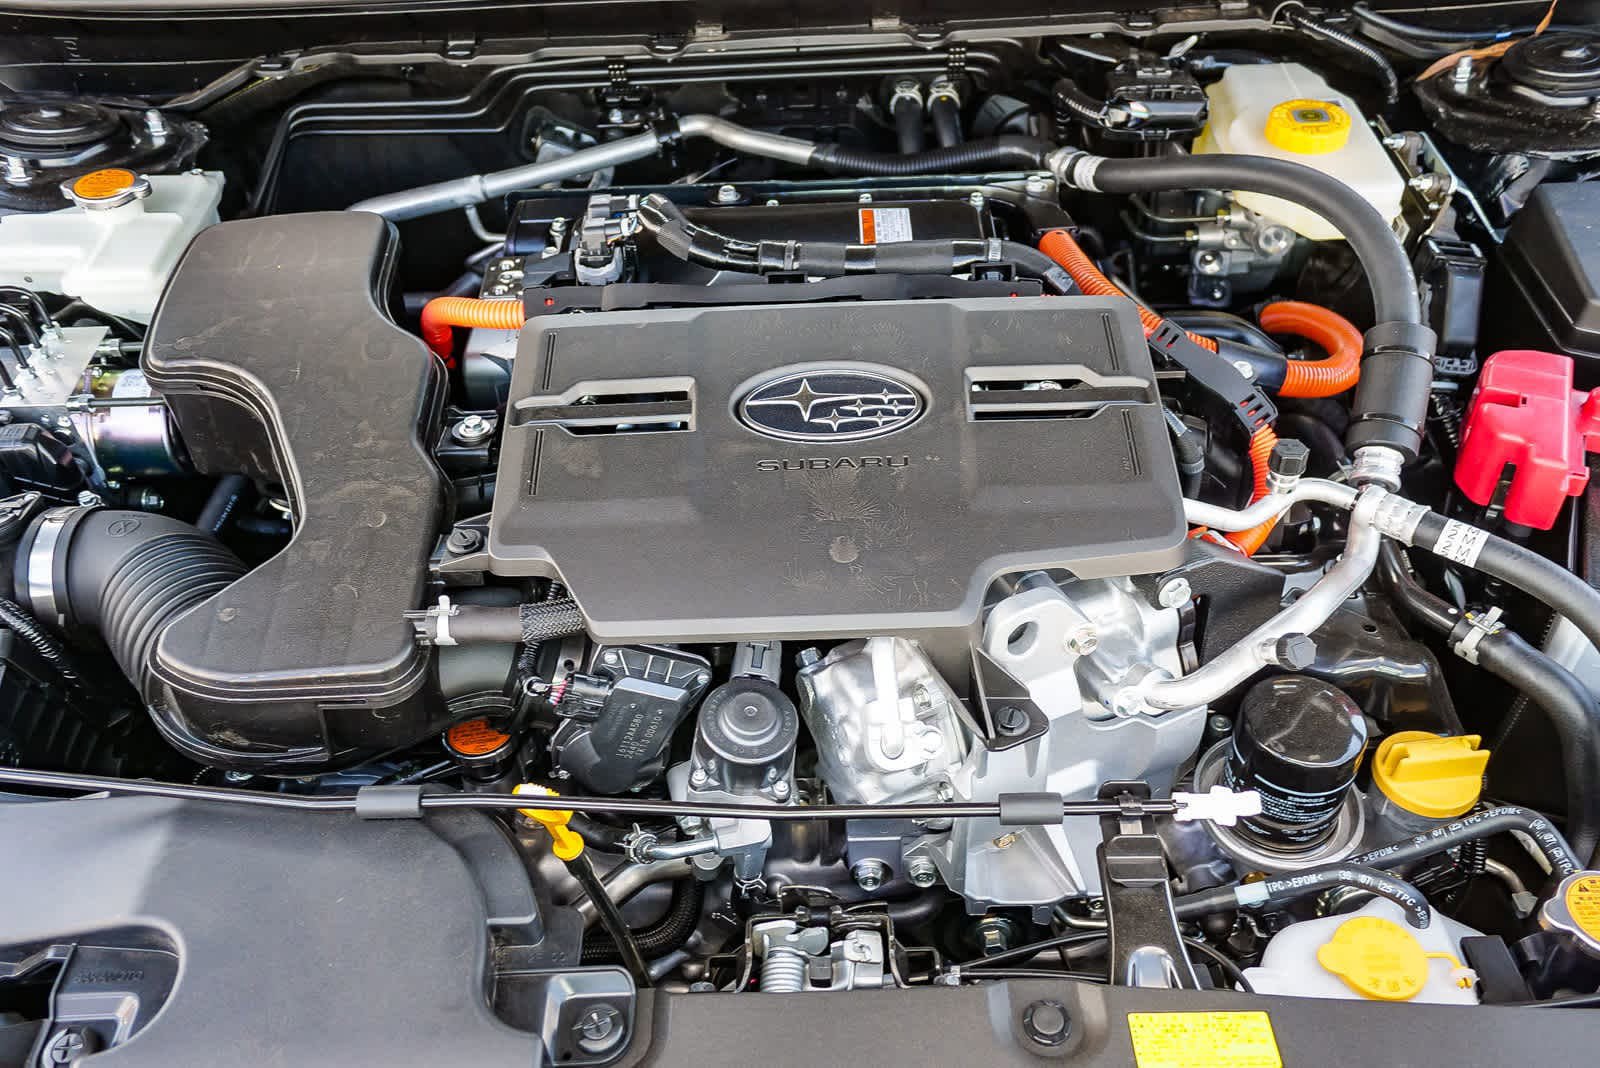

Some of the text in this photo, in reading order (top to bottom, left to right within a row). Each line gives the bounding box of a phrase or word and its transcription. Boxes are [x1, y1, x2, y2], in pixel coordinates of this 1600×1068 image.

[756, 455, 909, 472] SUBARU
[1267, 882, 1284, 893] TPC
[1395, 889, 1416, 906] TPC
